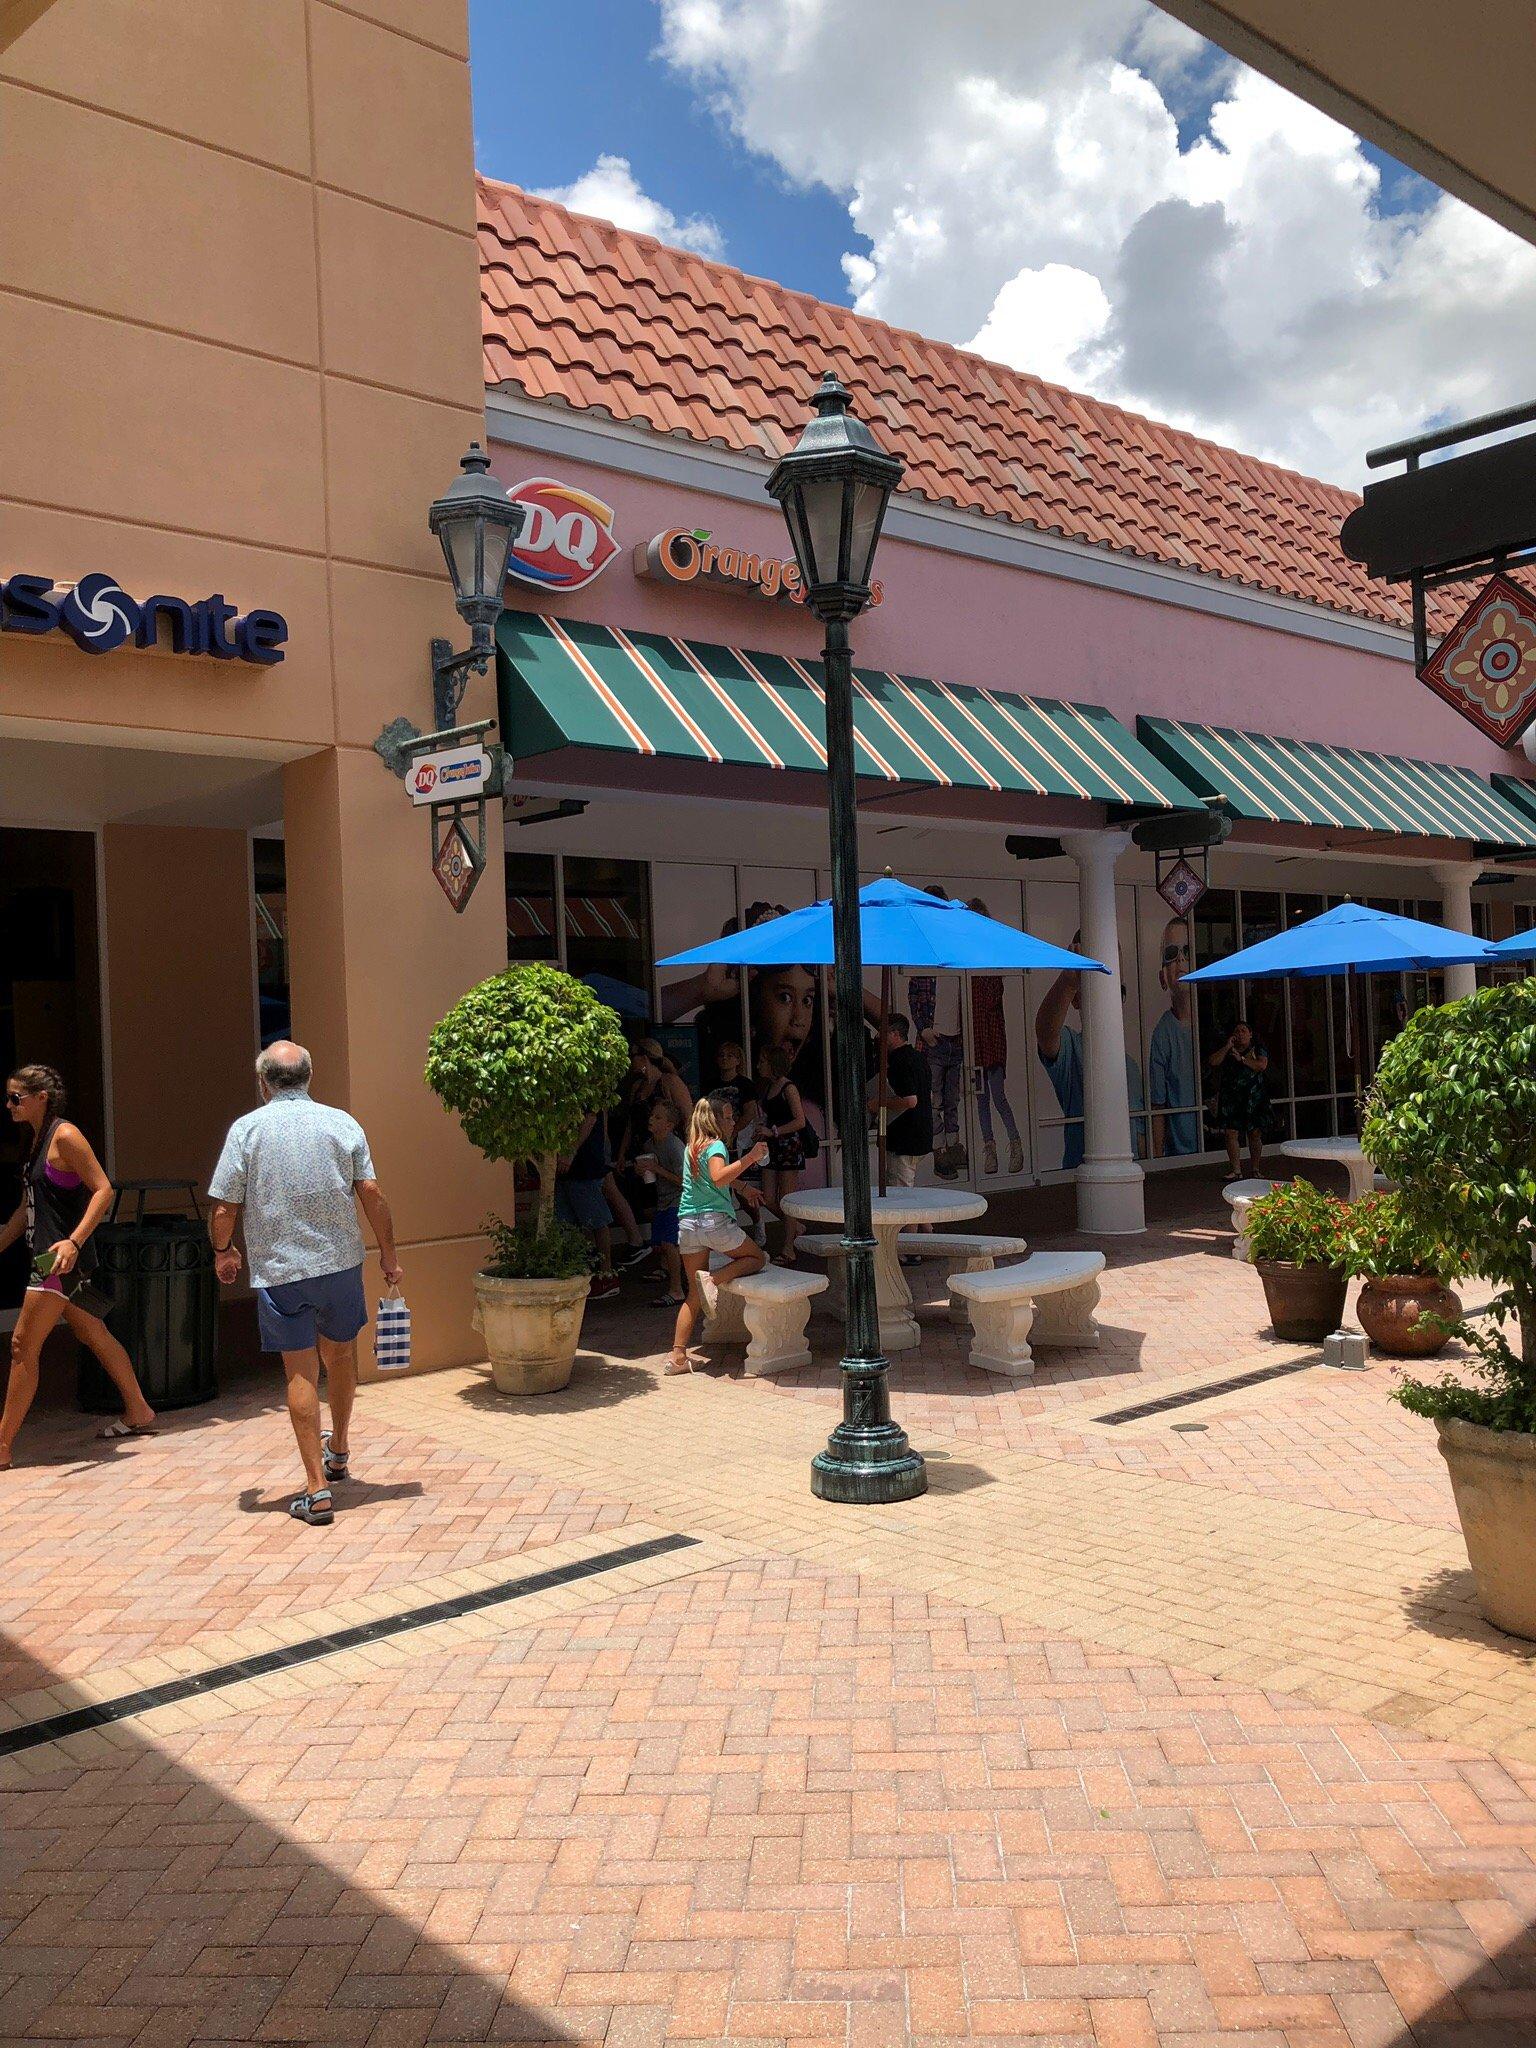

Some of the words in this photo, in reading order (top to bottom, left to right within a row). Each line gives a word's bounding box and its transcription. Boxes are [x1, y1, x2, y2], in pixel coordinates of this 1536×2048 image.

[513, 499, 598, 571] DQ
[655, 526, 801, 597] Orange
[0, 573, 288, 663] sonite
[418, 770, 435, 788] DQ
